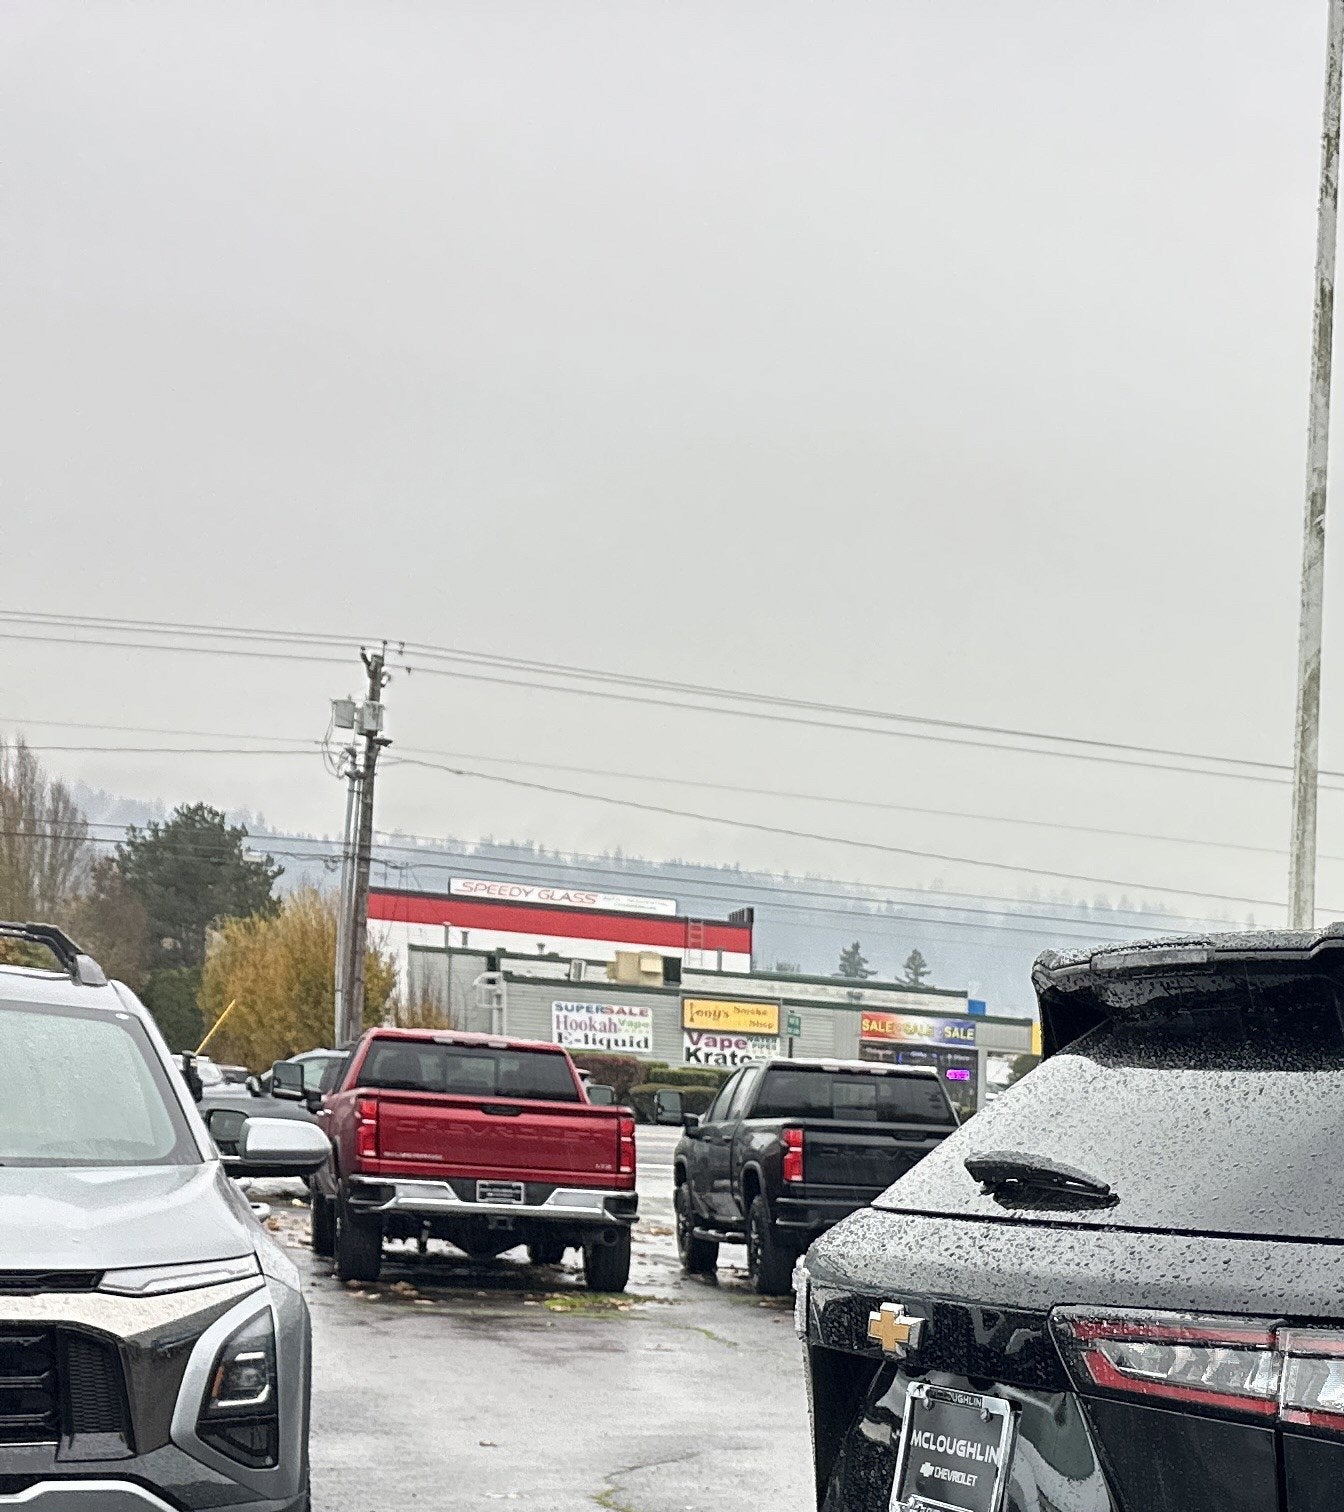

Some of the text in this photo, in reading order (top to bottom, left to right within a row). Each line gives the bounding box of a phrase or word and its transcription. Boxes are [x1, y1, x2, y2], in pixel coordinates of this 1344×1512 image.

[455, 881, 534, 898] SPEEDY
[538, 889, 598, 905] GLASS
[556, 1014, 650, 1033] Hookah Vape
[862, 1018, 894, 1034] SALE
[944, 1026, 975, 1041] SALE
[557, 1032, 649, 1050] E-liquid
[686, 1031, 748, 1051] Vape
[910, 1429, 1001, 1466] MCLOUGHLIN
[933, 1466, 978, 1487] CHEVROLET
